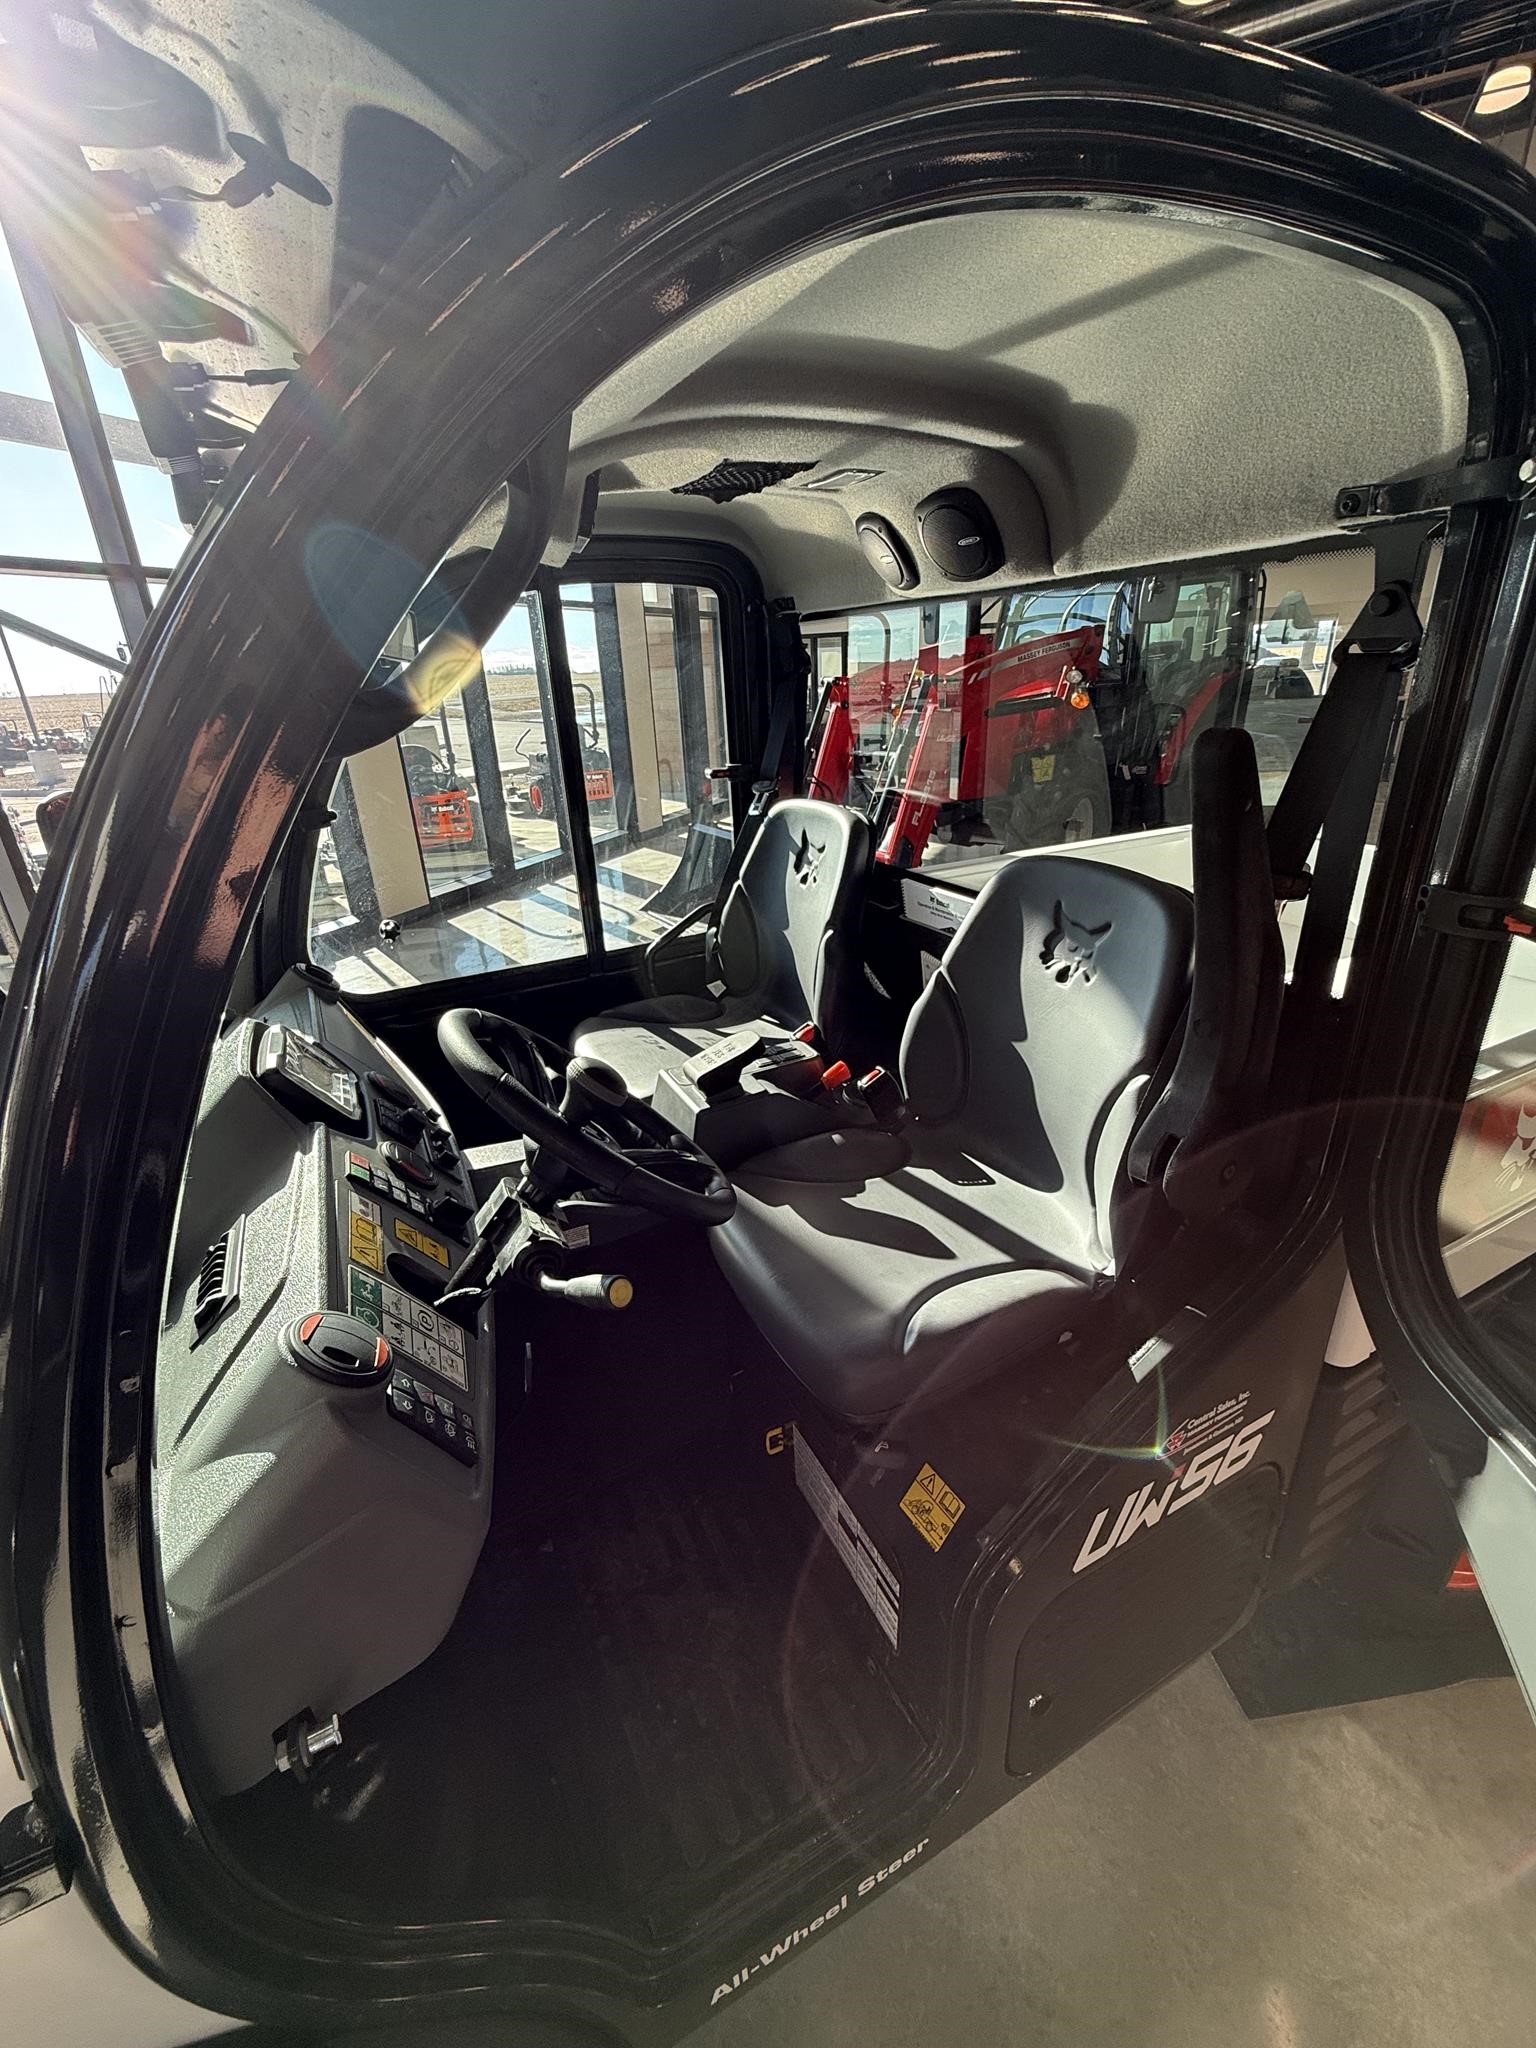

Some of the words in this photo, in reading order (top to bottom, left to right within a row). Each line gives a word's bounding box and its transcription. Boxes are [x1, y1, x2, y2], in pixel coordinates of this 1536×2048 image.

[1017, 649, 1041, 663] MASSEY
[1042, 640, 1071, 656] FERGUSON
[1187, 1407, 1216, 1429] Central
[1072, 1410, 1275, 1574] UW56
[711, 1895, 847, 2006] All-Wheel
[858, 1838, 929, 1897] Steer
